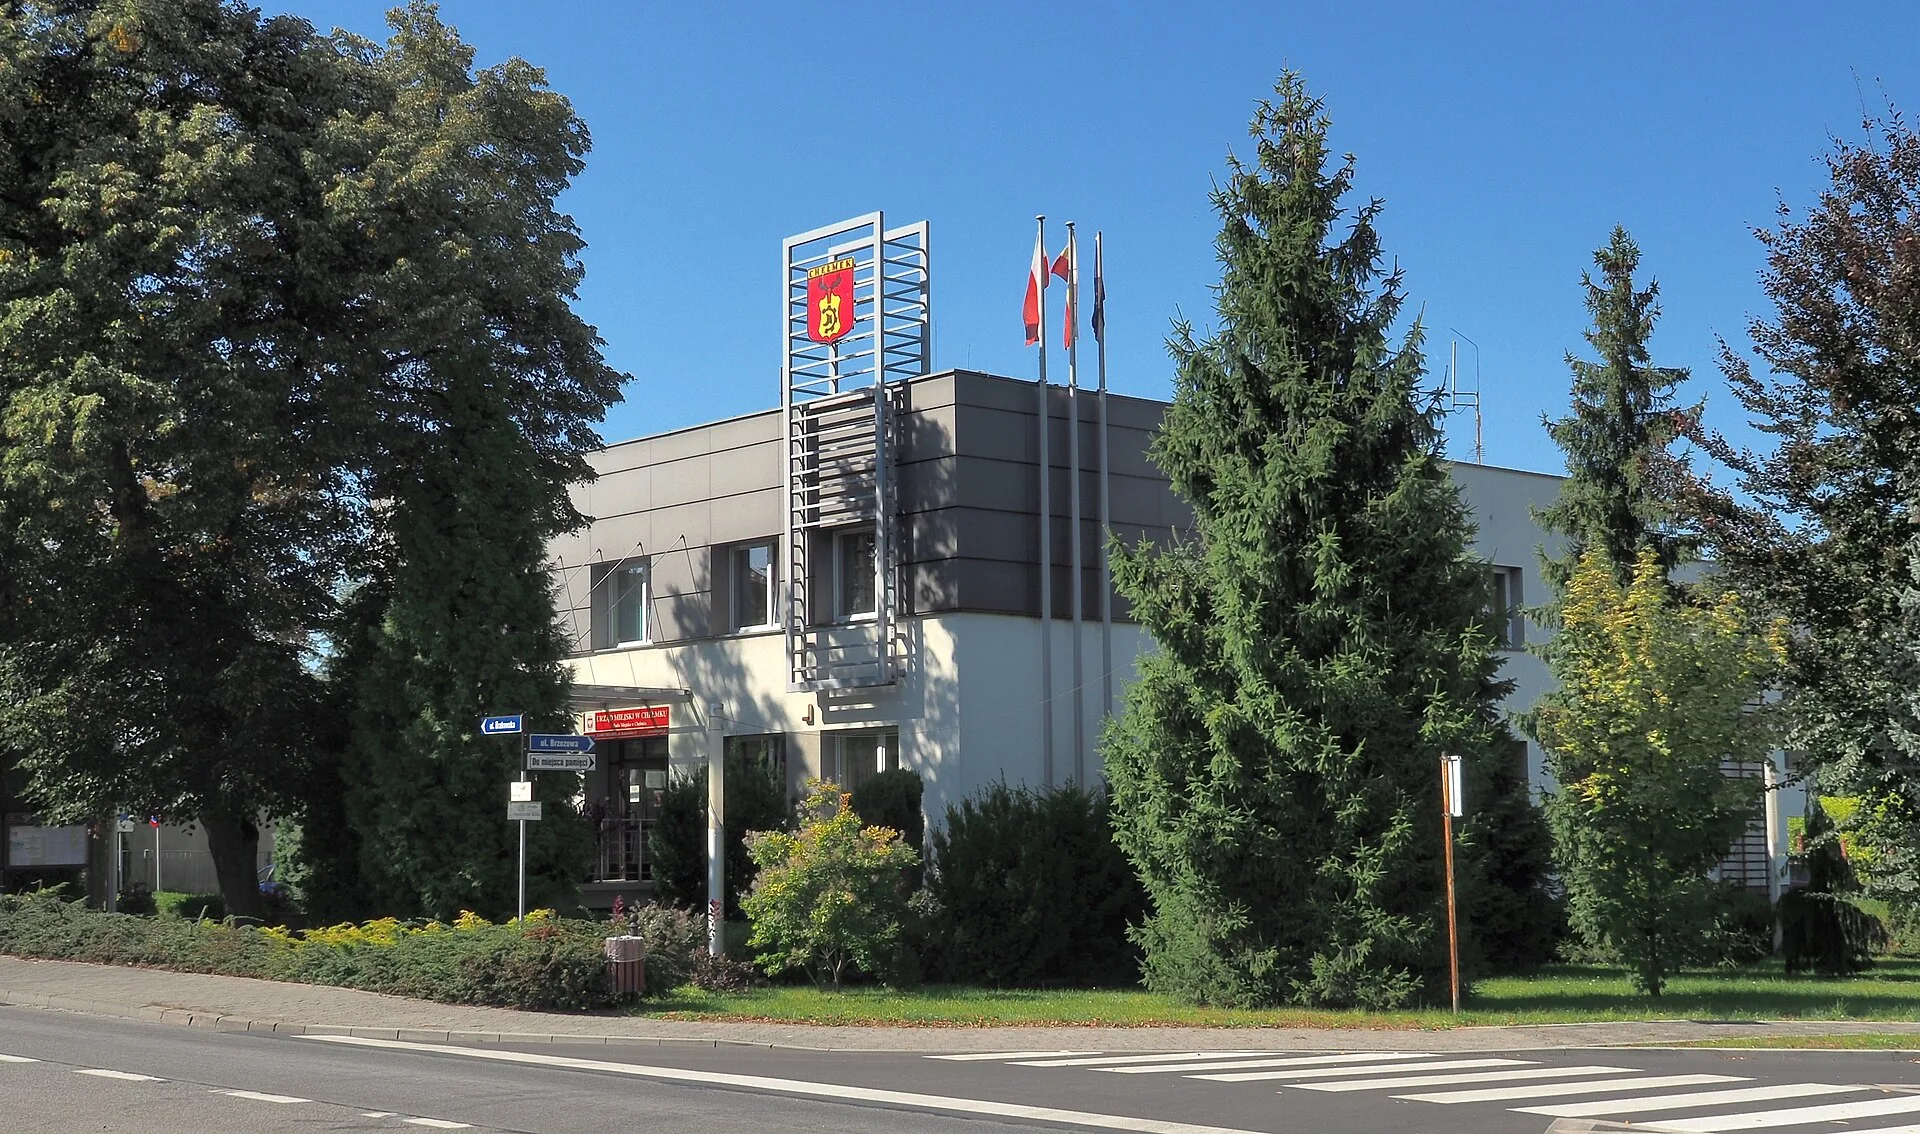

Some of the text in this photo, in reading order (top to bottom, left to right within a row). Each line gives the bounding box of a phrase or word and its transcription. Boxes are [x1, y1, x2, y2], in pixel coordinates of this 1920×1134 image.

[809, 259, 851, 278] CHEŁMEK
[614, 712, 635, 721] MIEJSKI
[540, 738, 579, 748] ul. Brzozowa
[532, 757, 588, 768] Do miejsca pamięci
